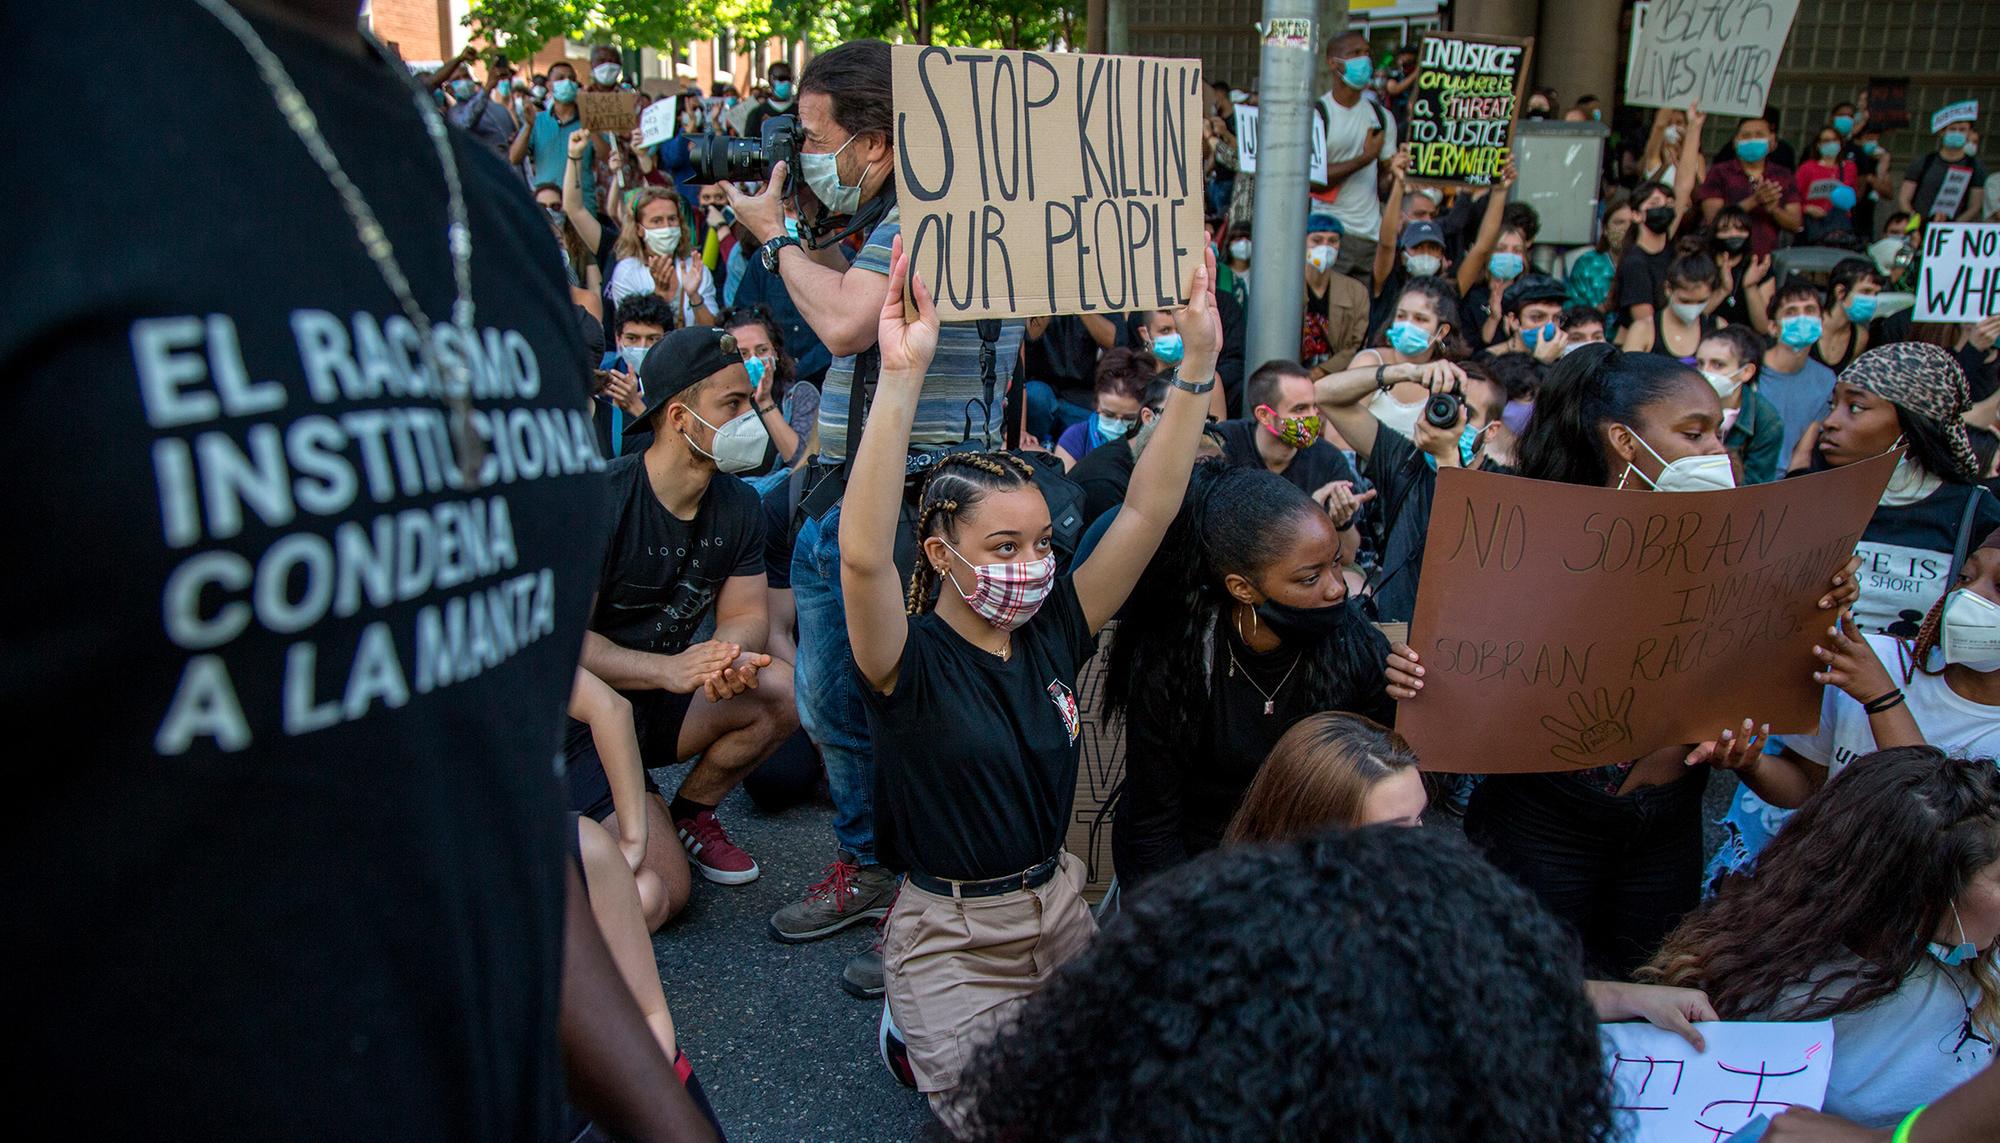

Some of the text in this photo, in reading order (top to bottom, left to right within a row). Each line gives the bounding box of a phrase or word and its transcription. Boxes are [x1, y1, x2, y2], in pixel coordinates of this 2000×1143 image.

[1420, 37, 1521, 75] INJUSTICE
[1701, 45, 1771, 107] MATER
[586, 114, 635, 129] MATTER
[900, 46, 1200, 201] STOP KILLIN'
[1413, 97, 1509, 121] a THREAT
[1410, 120, 1508, 147] TO JUSTICE
[1407, 142, 1510, 178] EVERYWHERE
[909, 195, 1190, 313] OUR PEOPLE
[1926, 228, 2000, 258] IF NO
[129, 313, 288, 429] EL
[1449, 497, 1789, 577] NO SOBRAN
[162, 495, 518, 649] CONDENA
[1870, 574, 1923, 593] SHORT
[1909, 558, 1938, 580] IS
[154, 567, 555, 755] A LA MANTA
[1435, 638, 1597, 688] SOBRAN
